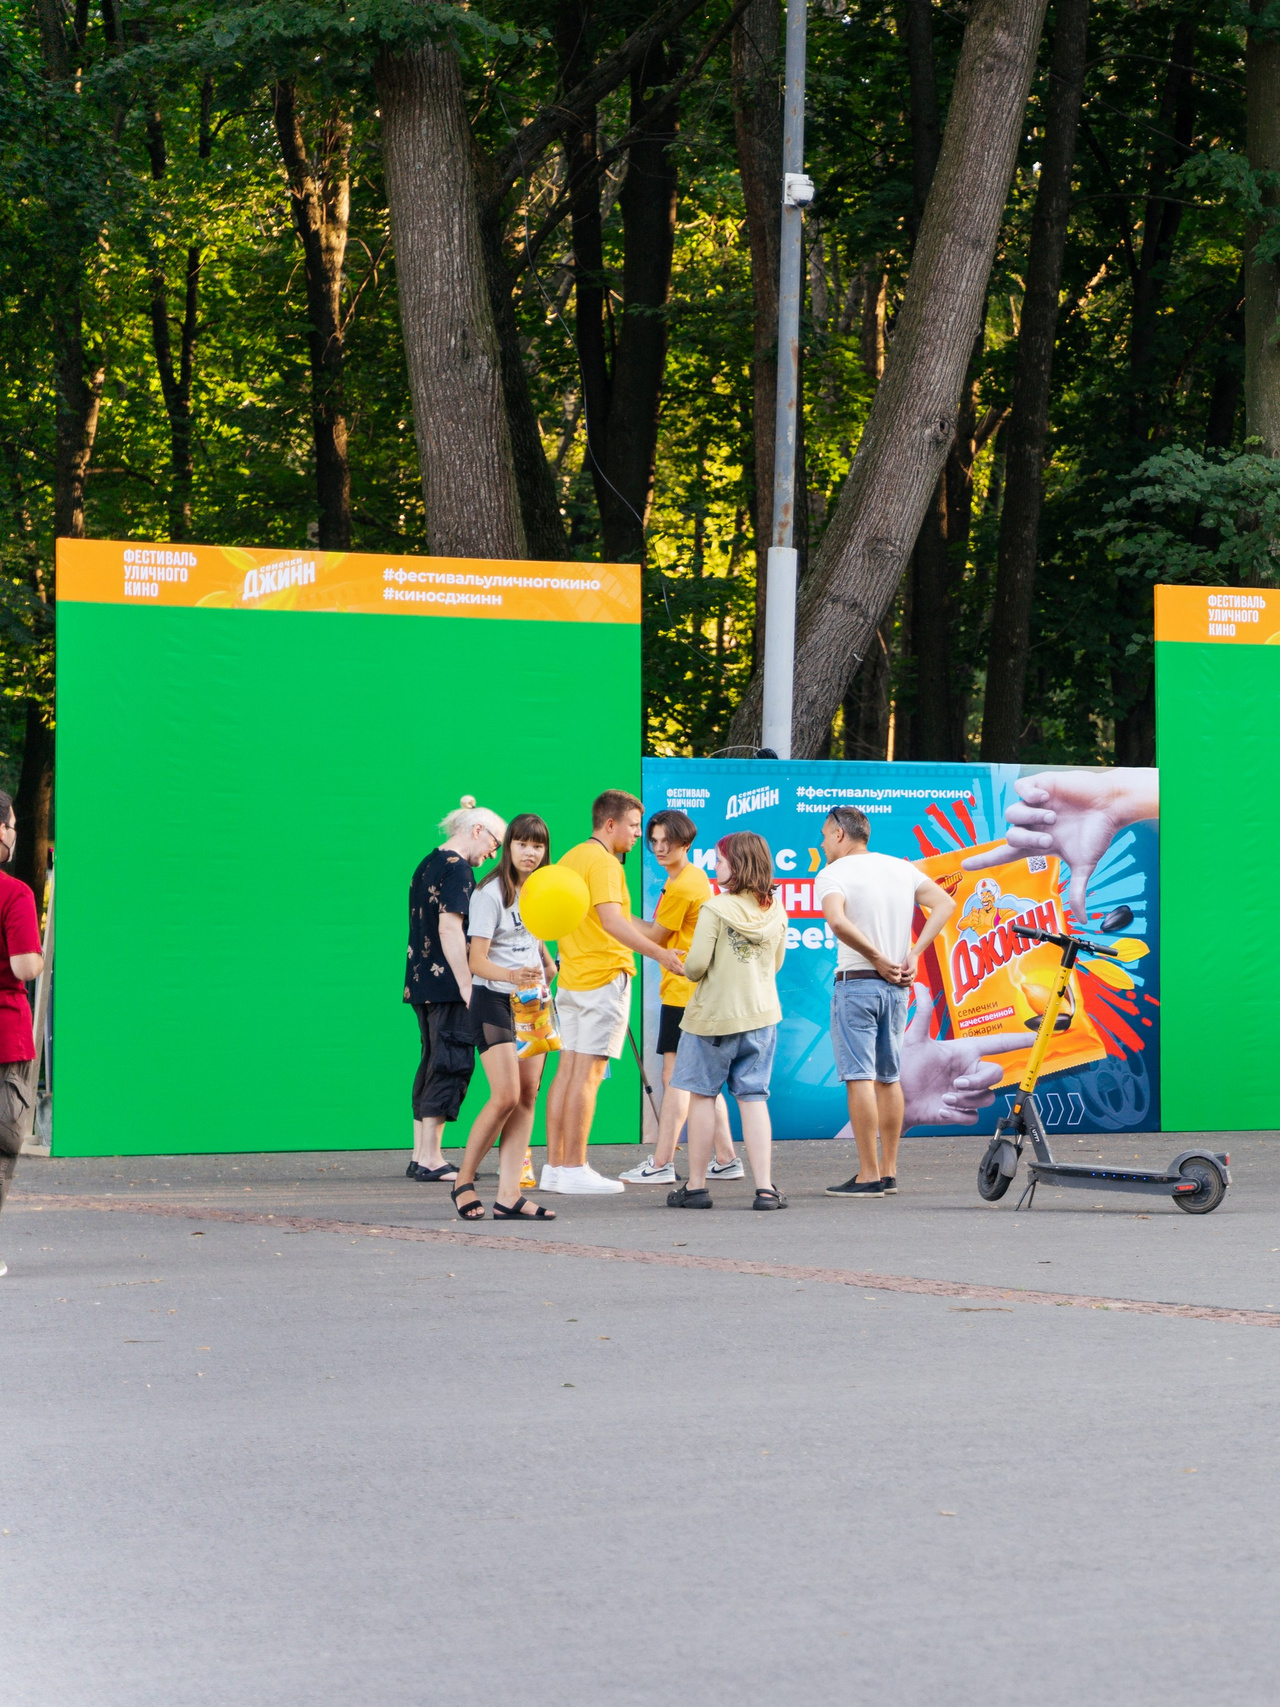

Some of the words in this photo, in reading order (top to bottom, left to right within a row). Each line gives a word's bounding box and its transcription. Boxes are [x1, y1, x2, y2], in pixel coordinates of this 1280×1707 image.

[124, 549, 197, 567] ФЕСТИВАЛЬ
[124, 565, 188, 582] УЛИЧНОГО
[383, 567, 601, 590] #фестивальуличногокино
[124, 582, 159, 597] КИНО
[383, 587, 503, 605] #киносджинн
[1208, 595, 1266, 609] ФЕСТИВАЛЬ
[1208, 609, 1259, 623] УЛИЧНОГО
[1209, 623, 1236, 636] КИНО
[666, 788, 711, 798] ФЕСТИВАЛЬ
[796, 786, 972, 801] #фестивальуличногокино
[666, 798, 706, 808] УЛИЧНОГО
[796, 802, 892, 814] #кинжинн
[957, 1001, 999, 1018] семечки
[959, 1007, 1014, 1029] качественной
[962, 1022, 1003, 1038] обжарки
